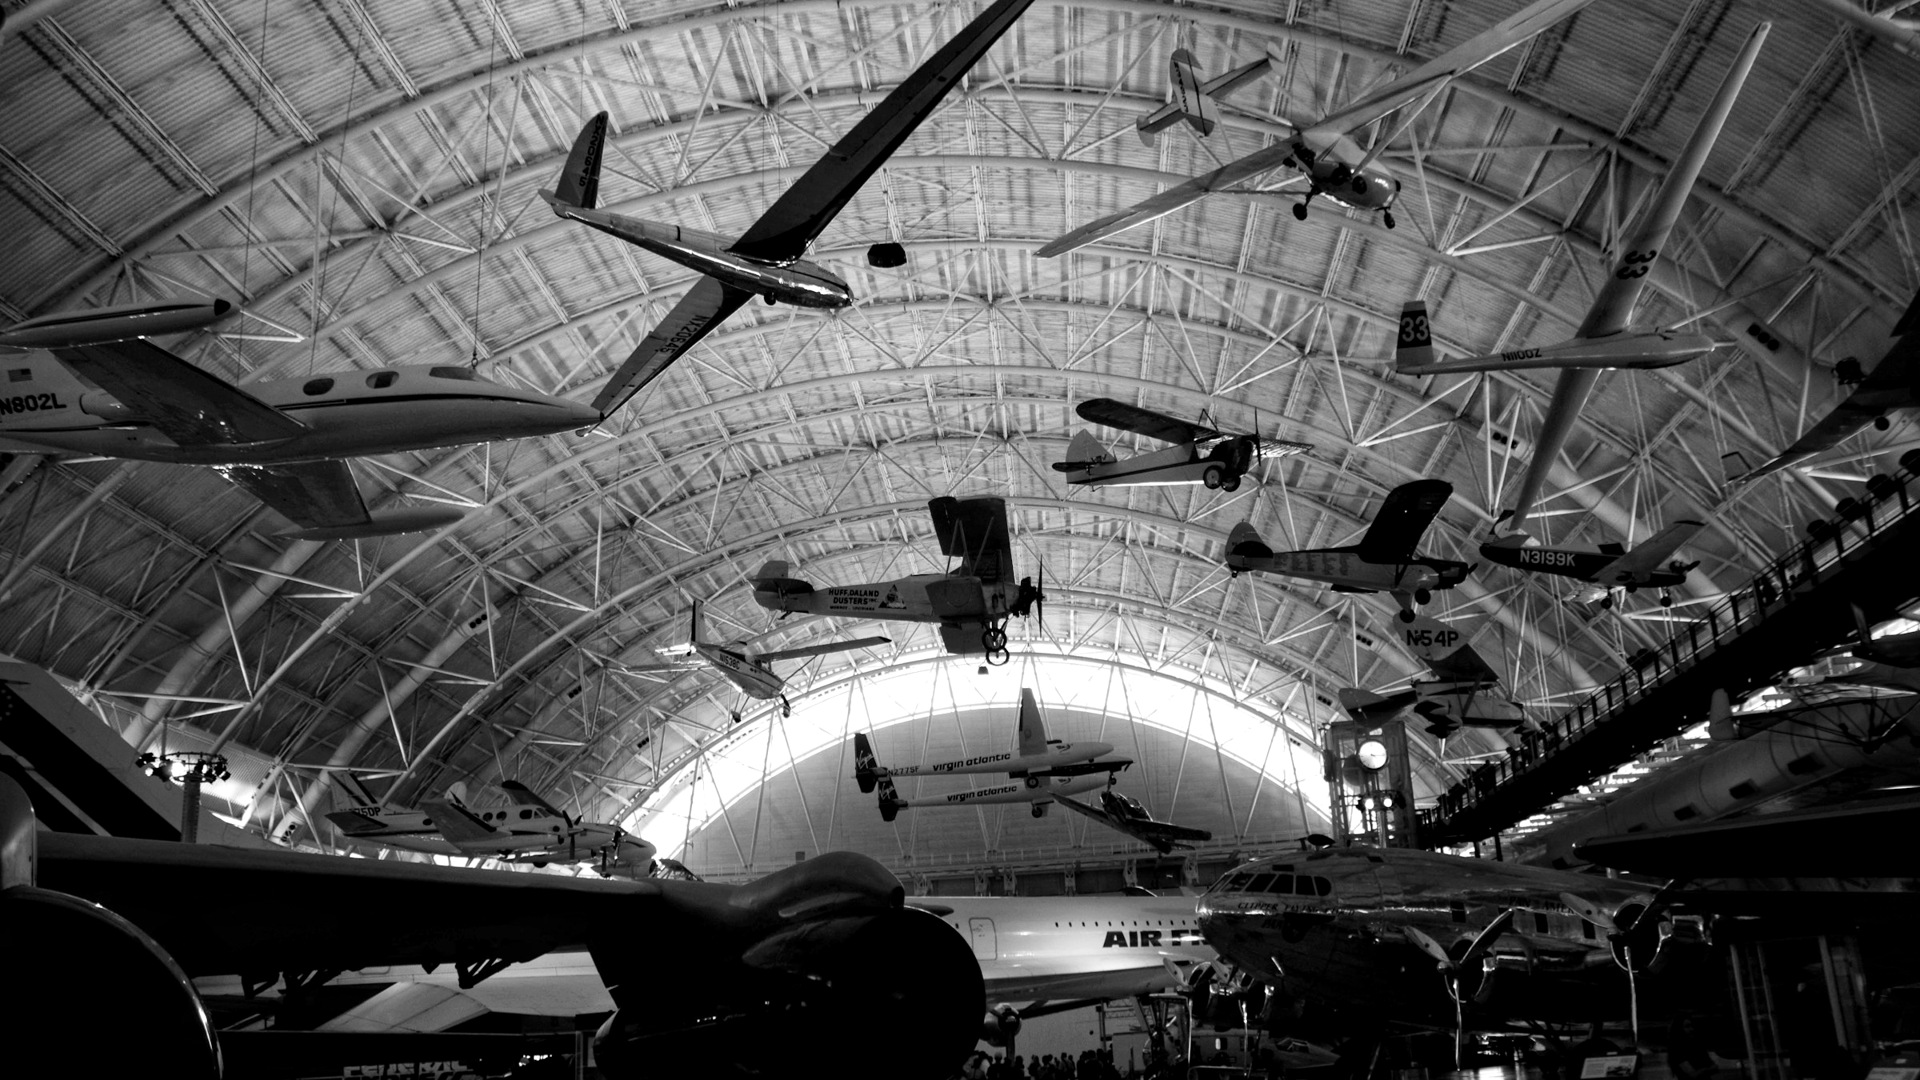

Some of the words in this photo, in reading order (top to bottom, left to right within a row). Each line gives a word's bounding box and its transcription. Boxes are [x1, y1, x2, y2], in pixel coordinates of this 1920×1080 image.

[578, 114, 605, 187] NX20645
[1400, 315, 1429, 342] 33
[1501, 348, 1542, 362] N1100Z
[0, 393, 67, 415] N802L
[1520, 549, 1577, 567] N3199K
[833, 597, 868, 605] DUSTERS
[1406, 629, 1459, 647] N54P
[932, 761, 964, 771] virgin
[966, 753, 1011, 766] atlantic
[947, 792, 975, 802] virgin
[977, 785, 1018, 797] atlantic
[1103, 930, 1162, 948] AIR
